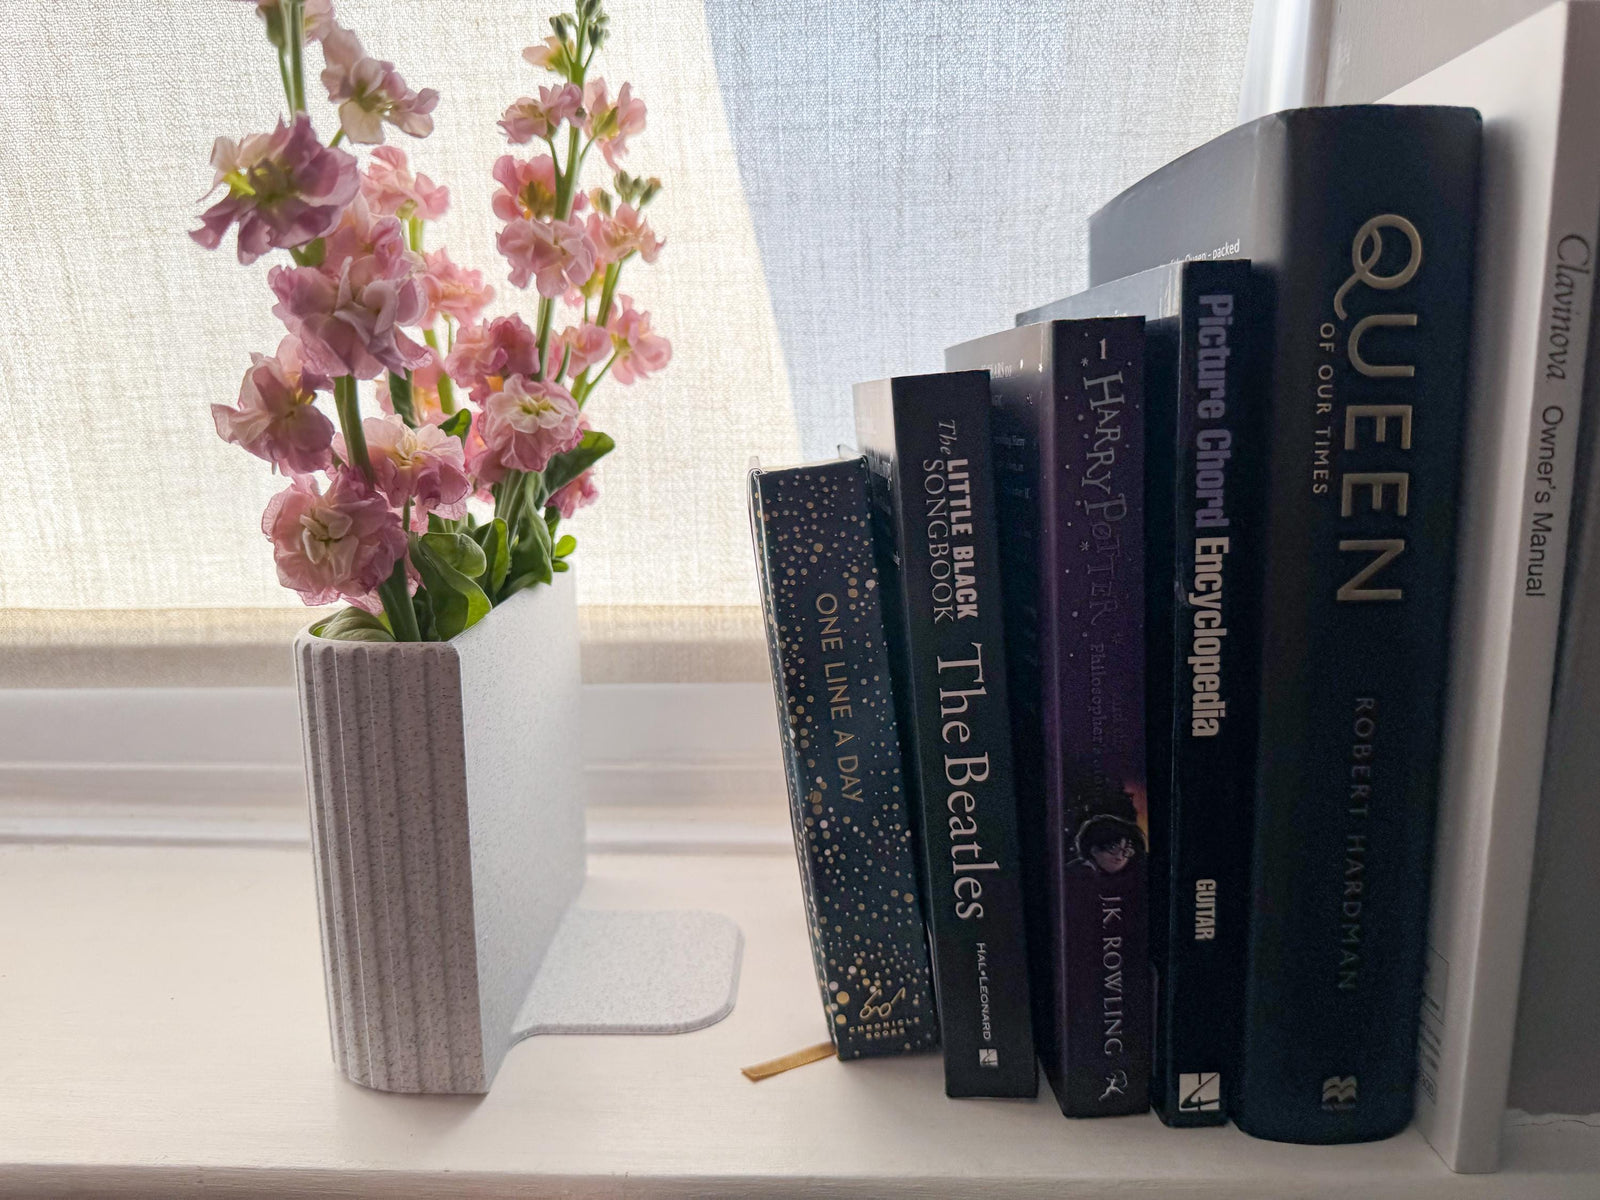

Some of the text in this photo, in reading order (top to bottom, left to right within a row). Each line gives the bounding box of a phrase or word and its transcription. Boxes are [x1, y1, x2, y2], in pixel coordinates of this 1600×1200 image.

[1212, 238, 1240, 260] packed
[1081, 371, 1128, 626] HARRY POTTER
[1312, 322, 1335, 496] OF OUR TIMES
[1333, 213, 1422, 602] QUEEN
[1525, 233, 1591, 597] Clavinova Owner's Manual
[923, 459, 954, 625] SONGBOOK
[938, 419, 979, 620] The LITTLE BLACK
[1187, 294, 1234, 737] Picture Chord Encyclopedia
[815, 593, 864, 803] ONE LINE A DAY
[936, 642, 1001, 920] The Beatles
[1195, 878, 1217, 941] GUITAR
[1337, 697, 1375, 990] ROBERT HARDMAN
[1102, 936, 1123, 1055] ROWLING
